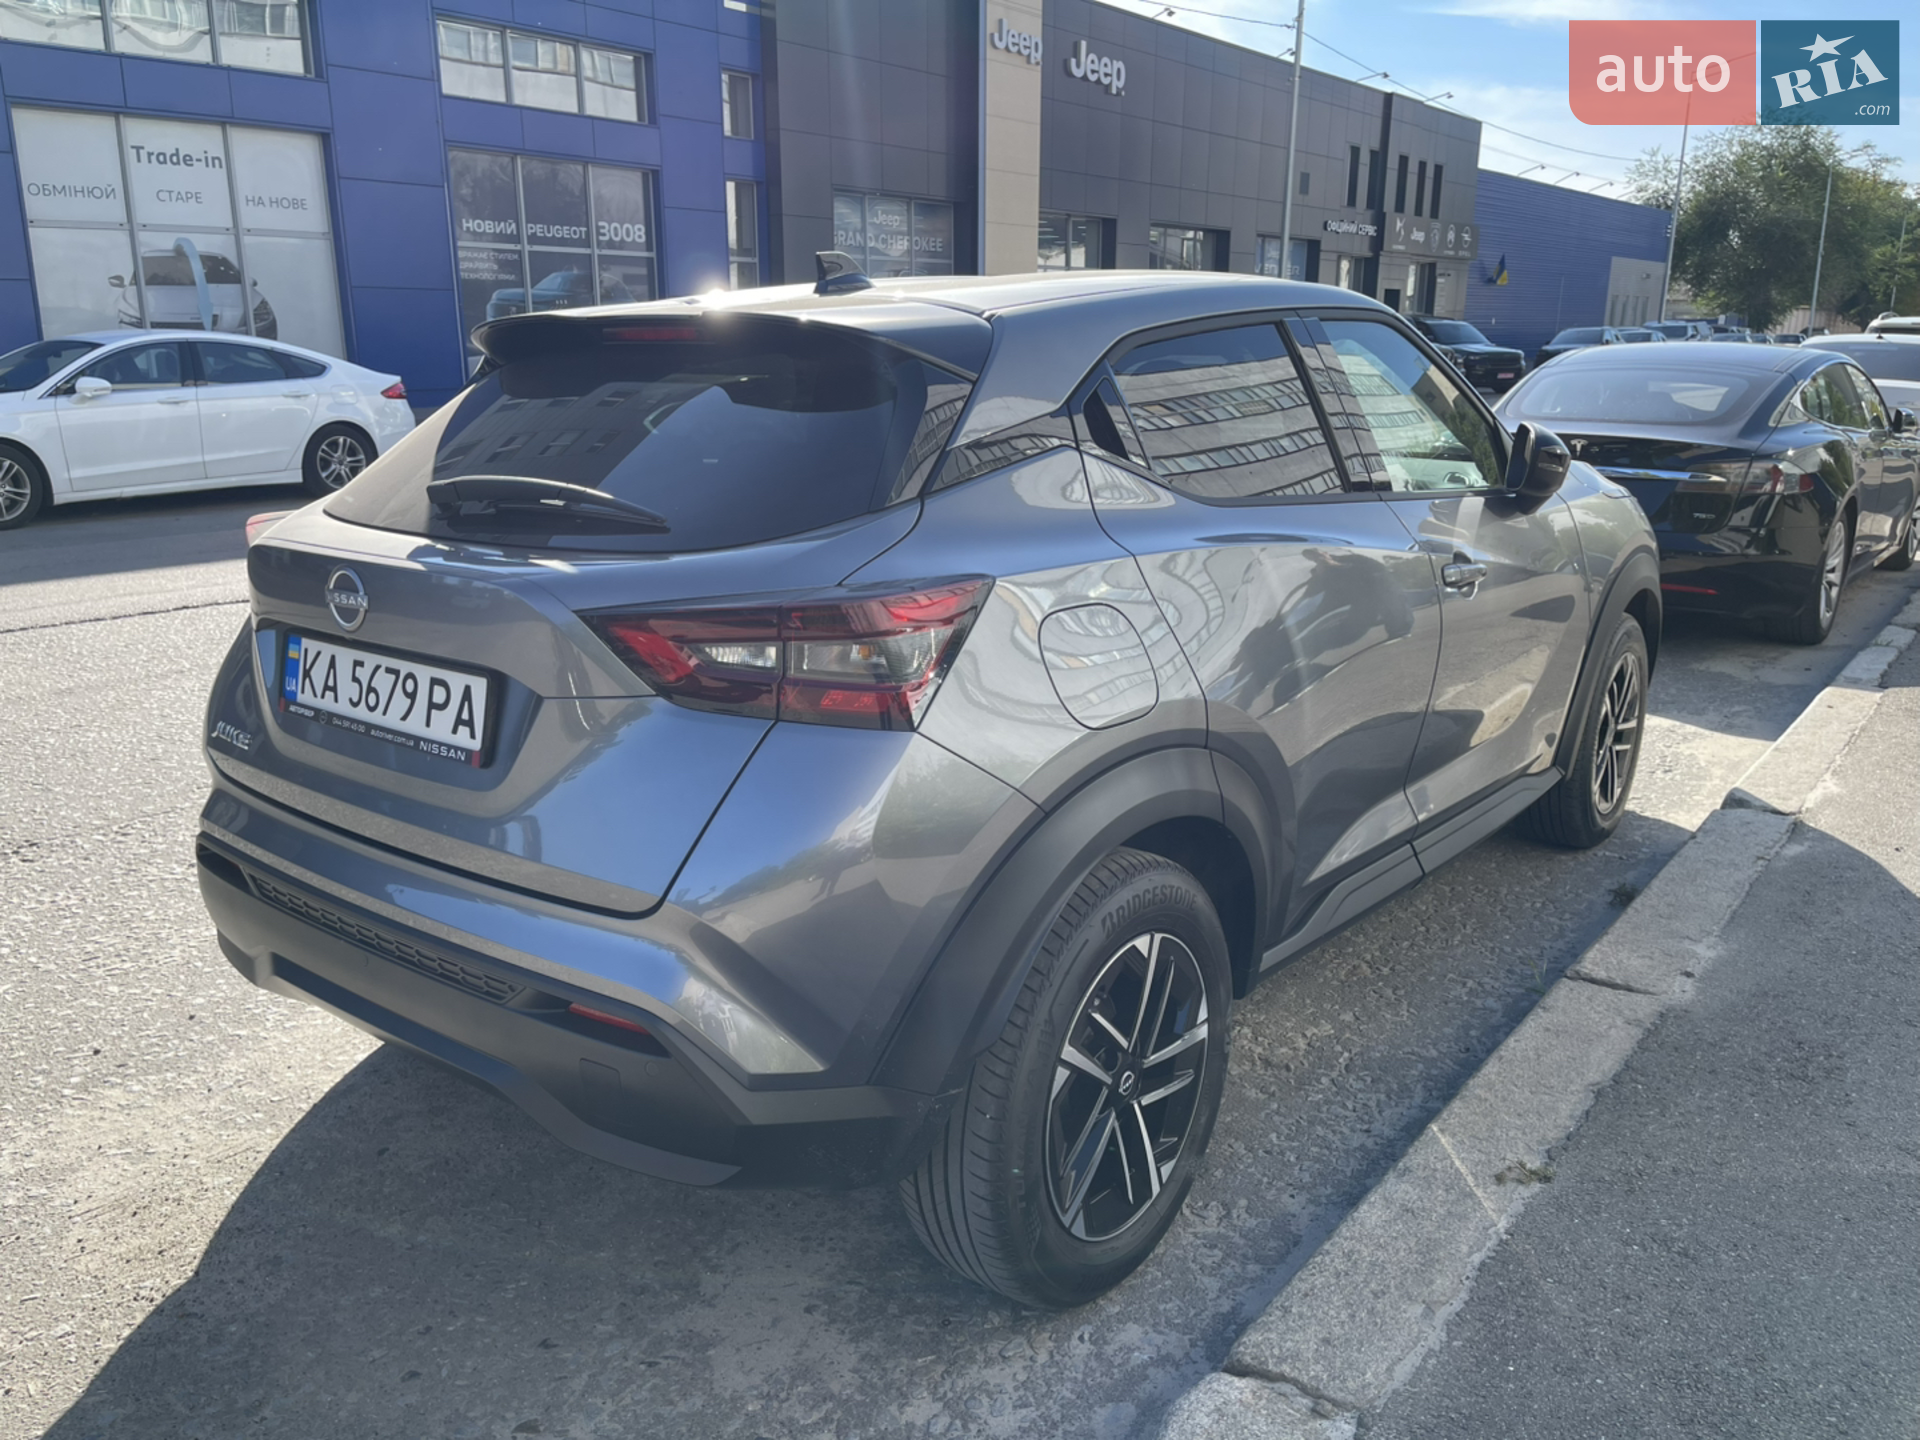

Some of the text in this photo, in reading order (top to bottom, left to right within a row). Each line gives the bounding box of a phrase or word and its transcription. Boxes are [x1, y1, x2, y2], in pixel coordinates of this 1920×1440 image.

[993, 18, 1043, 65] Jeep
[1070, 40, 1126, 95] Jeep
[130, 145, 224, 169] Trade-in
[27, 182, 309, 211] ОБМІНЮЙ СТАРЕ НА НОВЕ
[461, 218, 647, 243] НОВИЙ PEUGEOT 3008
[873, 210, 900, 229] Jeep
[879, 233, 944, 252] CHEROKEE
[328, 591, 367, 608] SSAN
[285, 676, 297, 693] UA
[301, 647, 477, 741] KA 5679 PA
[211, 720, 251, 750] JUKE
[419, 740, 467, 762] NISSAN
[1101, 884, 1198, 940] BRIDGESTONE
